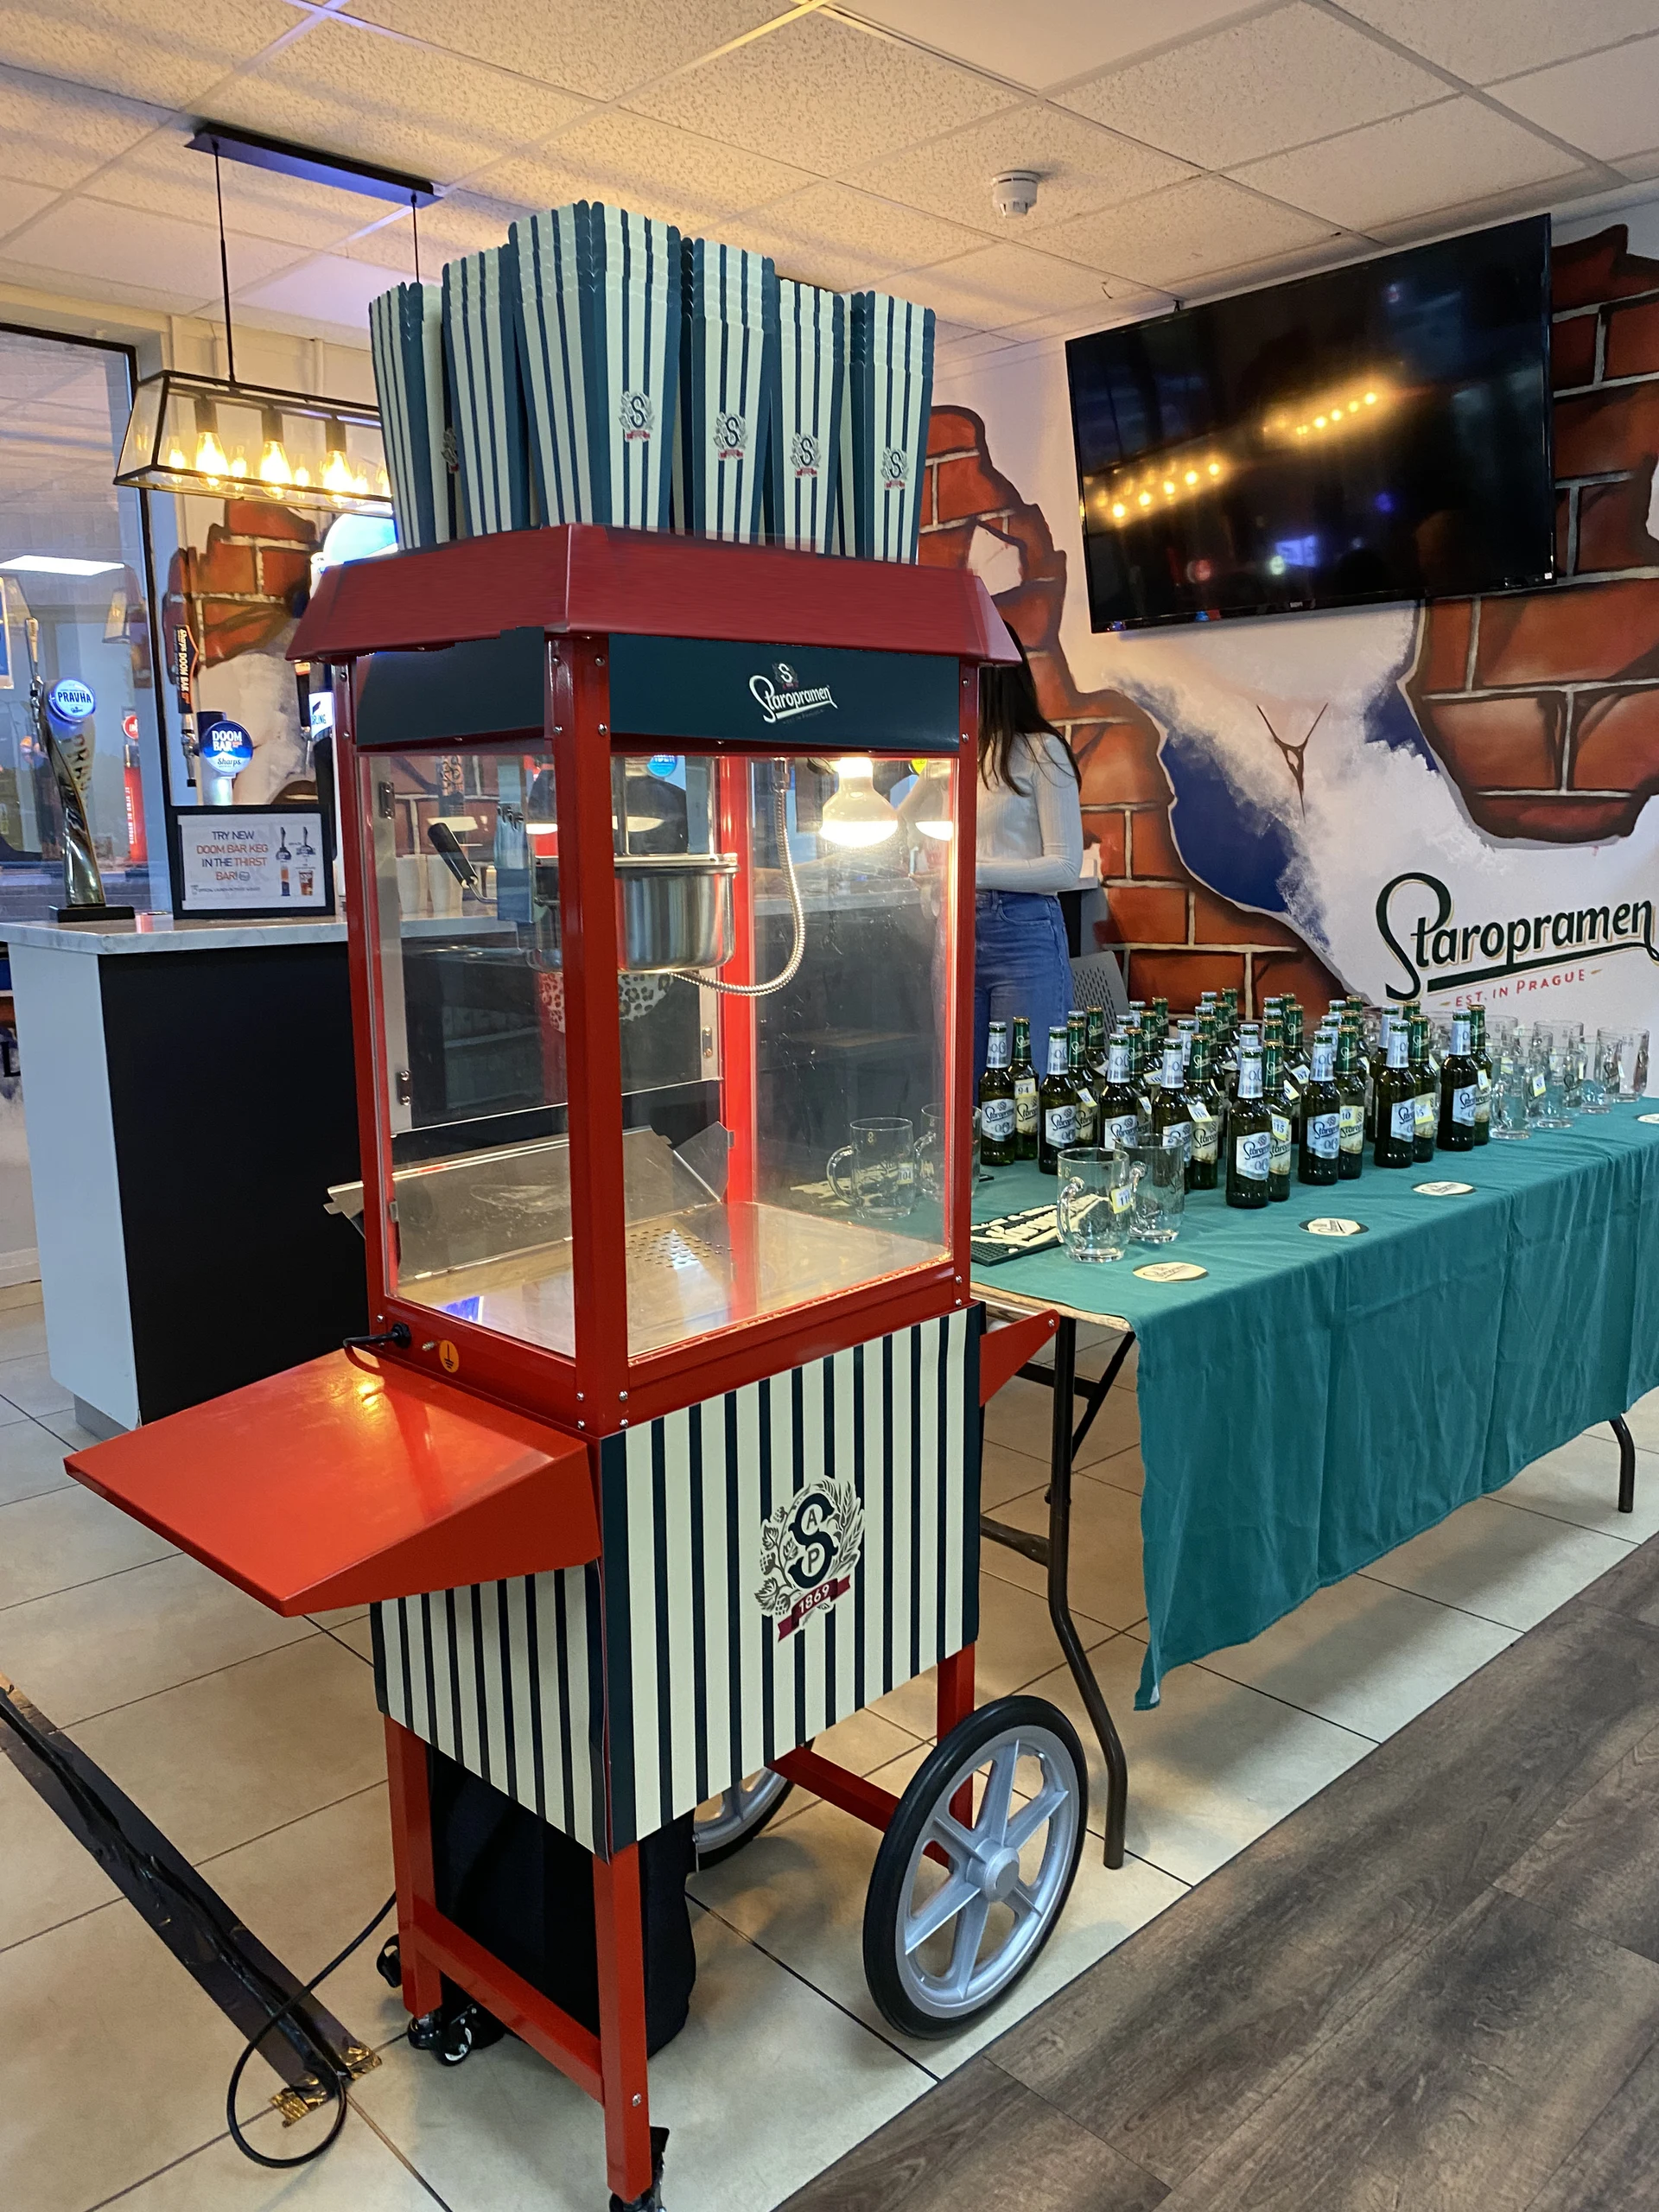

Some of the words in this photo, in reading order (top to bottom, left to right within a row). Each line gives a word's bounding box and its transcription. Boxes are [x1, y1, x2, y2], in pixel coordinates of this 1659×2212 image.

[179, 652, 188, 676] DOOM
[57, 691, 92, 704] PRAVHA
[749, 675, 838, 723] Staropramen
[212, 731, 243, 742] DOOM
[213, 741, 233, 752] BAR
[212, 831, 230, 841] TRY
[232, 830, 255, 840] NEW
[196, 845, 225, 855] DOOM
[226, 844, 246, 854] BAR
[249, 843, 269, 853] KEG
[202, 858, 213, 868] IN
[214, 858, 232, 867] THE
[233, 857, 267, 867] THIRST
[216, 871, 238, 880] BAR!
[1376, 872, 1659, 1001] Staropramen
[1456, 991, 1487, 1007] EST.
[1493, 987, 1509, 1000] IN
[1516, 969, 1585, 994] PRAGUE
[798, 1584, 830, 1614] 1869
